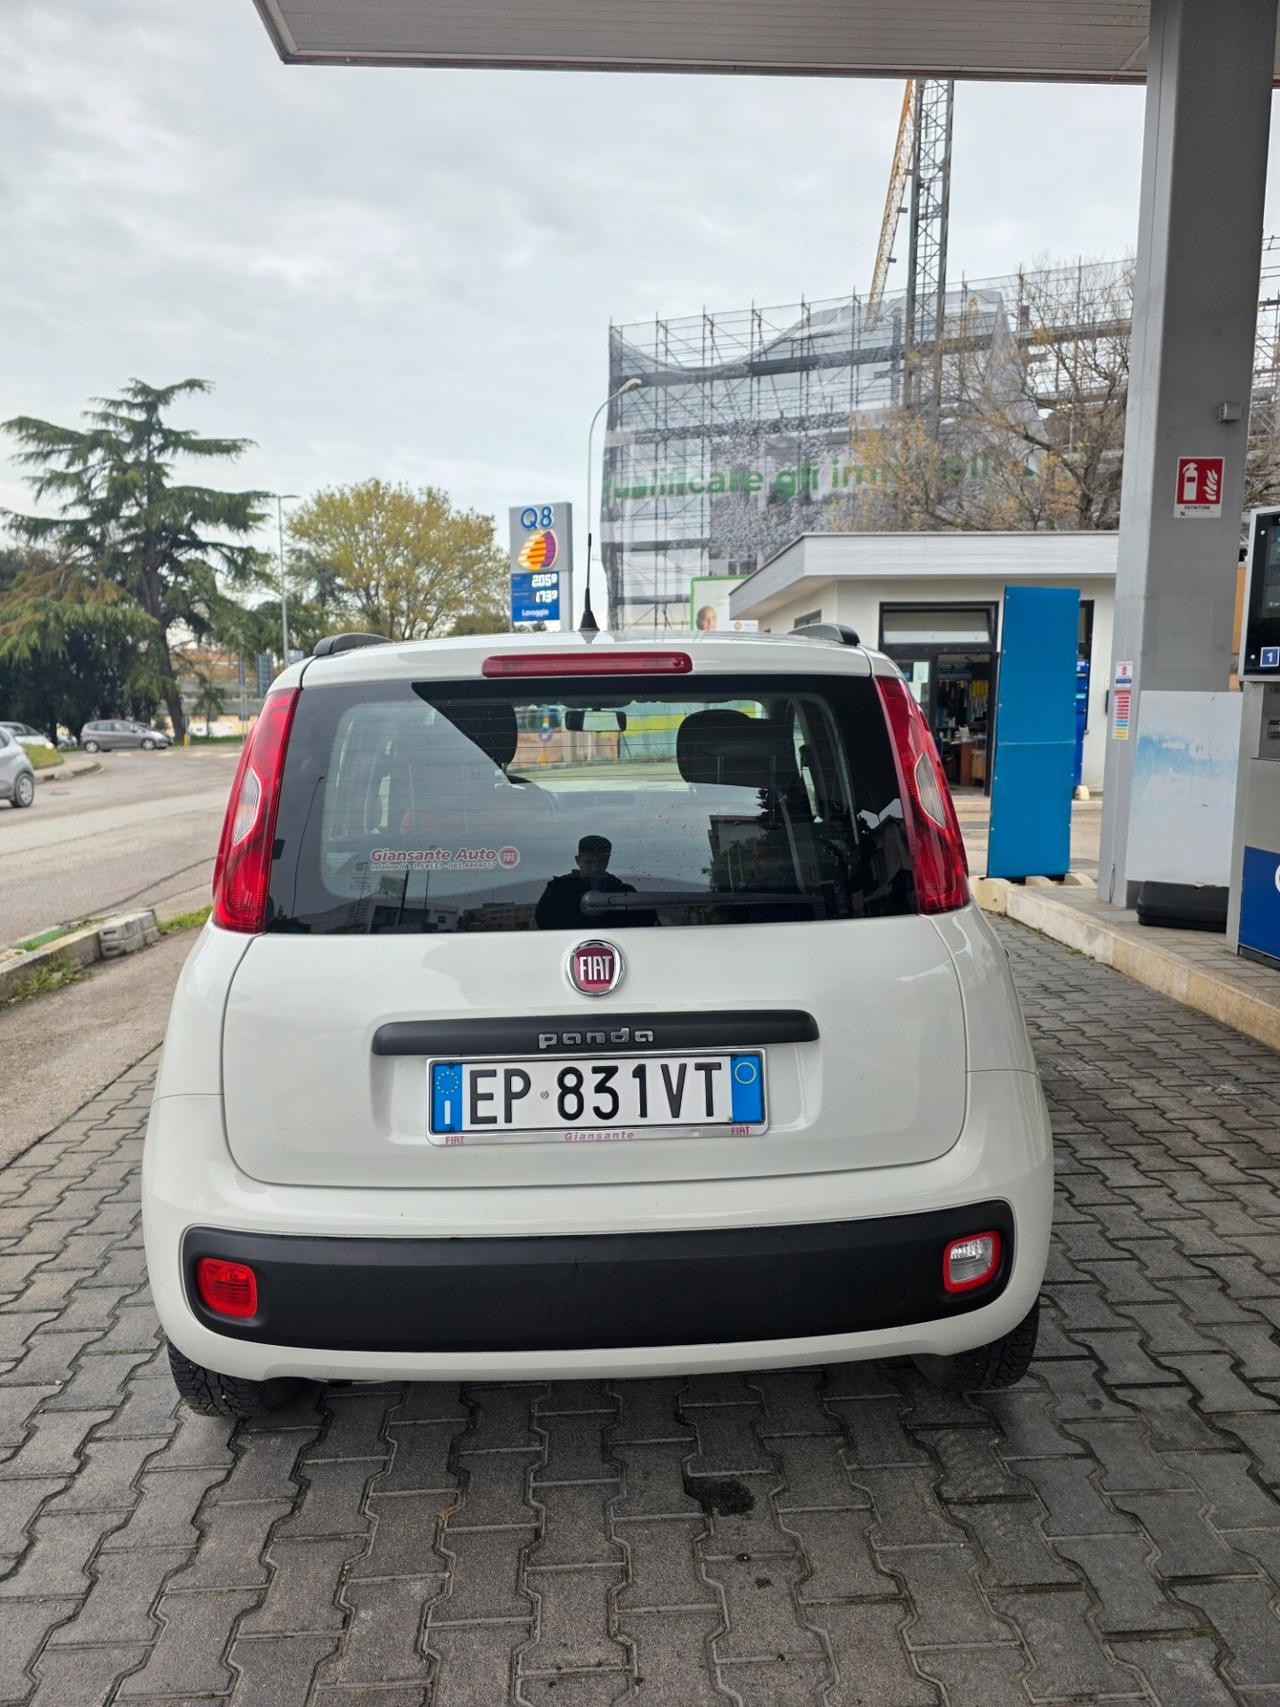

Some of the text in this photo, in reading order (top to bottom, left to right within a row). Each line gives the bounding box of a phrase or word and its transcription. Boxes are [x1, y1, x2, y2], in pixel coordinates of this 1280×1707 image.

[520, 506, 552, 529] Q8
[1266, 652, 1273, 662] 1
[371, 847, 497, 862] Giansante Auto
[579, 955, 612, 981] FIAT
[538, 1027, 655, 1049] panda
[469, 1069, 531, 1125] EP
[564, 1130, 634, 1141] Giansante
[731, 1126, 750, 1136] FIAT
[445, 1135, 465, 1146] FIAT
